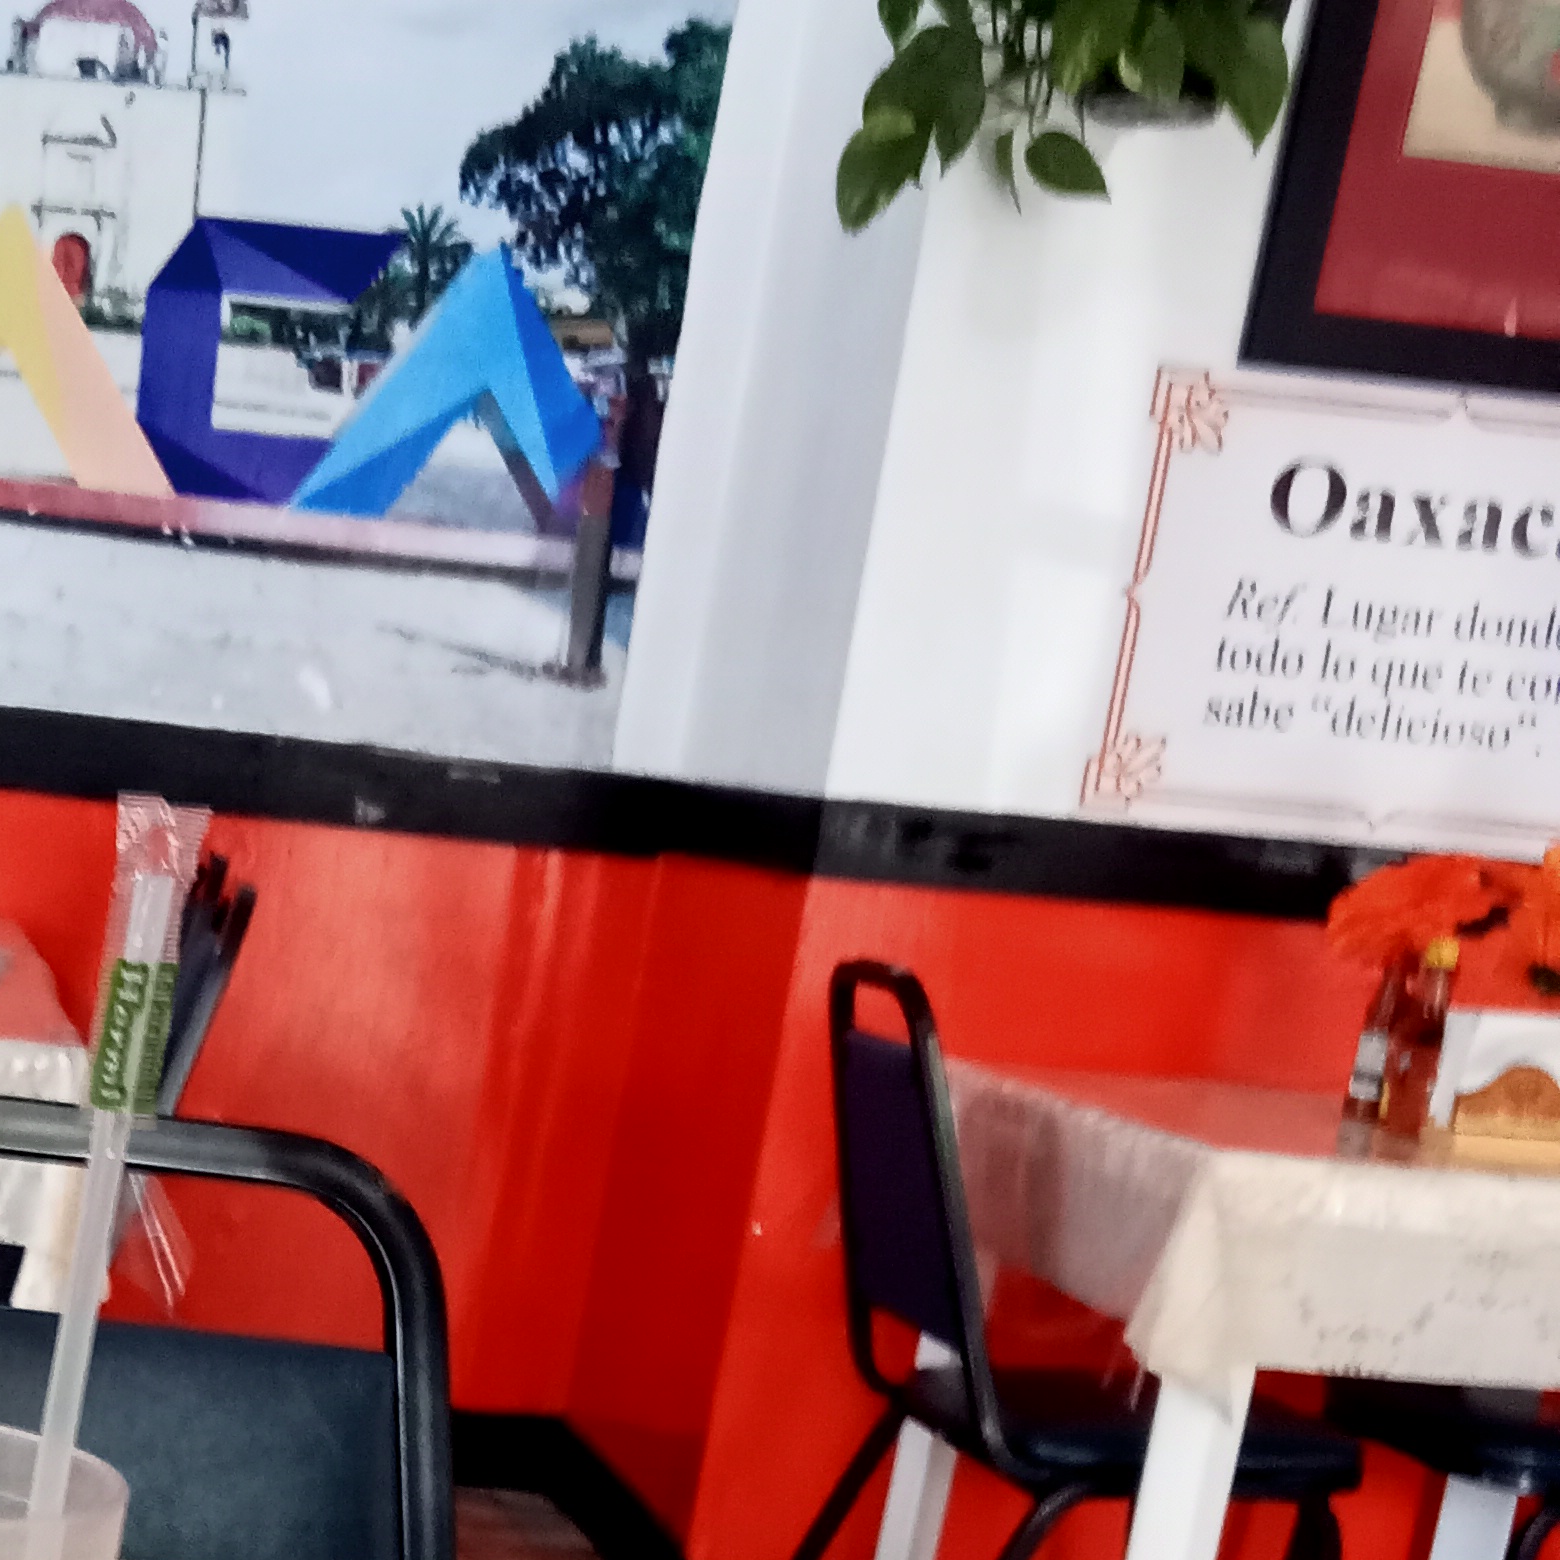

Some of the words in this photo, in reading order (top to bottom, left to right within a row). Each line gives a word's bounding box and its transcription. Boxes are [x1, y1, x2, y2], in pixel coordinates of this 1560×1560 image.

[1270, 456, 1560, 562] Oaxac
[1454, 600, 1560, 652] dond
[1216, 636, 1306, 680] todo
[1321, 638, 1358, 683] lo
[1371, 656, 1444, 698] que
[1204, 686, 1294, 734] sabe
